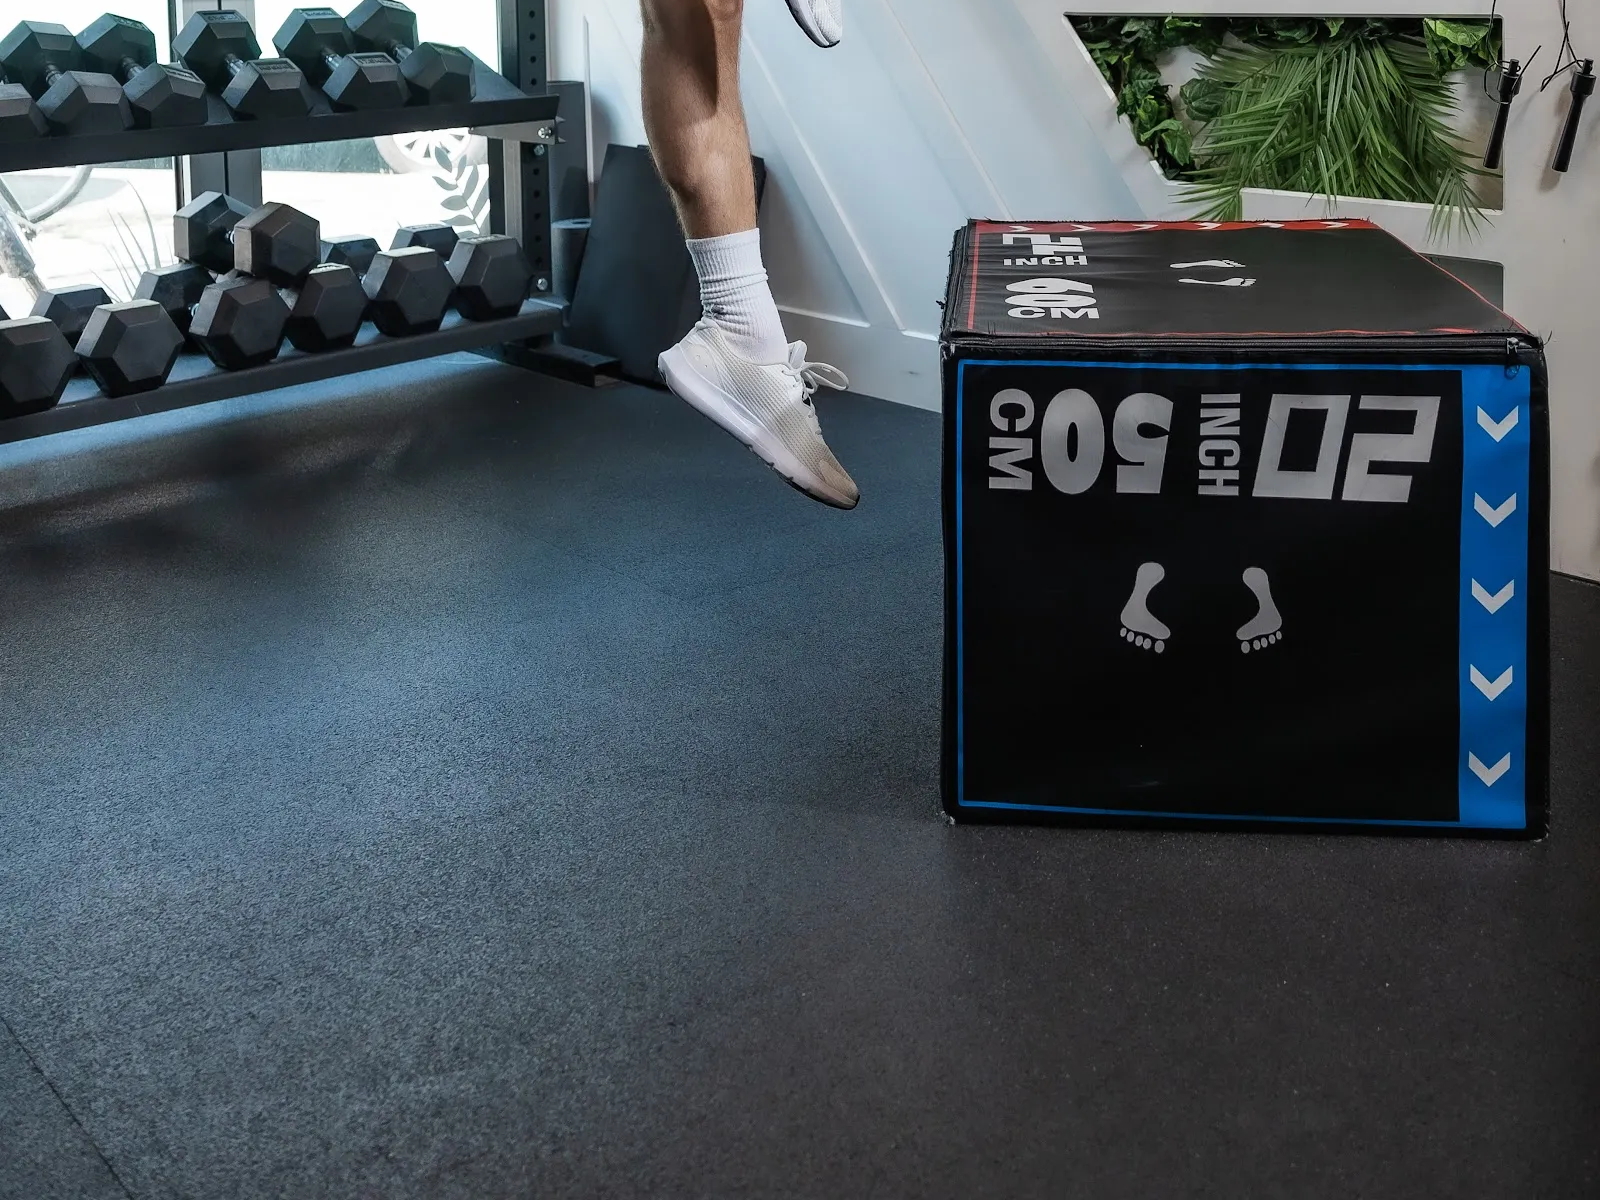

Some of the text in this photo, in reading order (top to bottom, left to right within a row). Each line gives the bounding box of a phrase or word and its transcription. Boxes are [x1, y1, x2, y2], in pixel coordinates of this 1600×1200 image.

[1003, 255, 1088, 266] INCH
[1004, 277, 1097, 308] 60
[1007, 306, 1100, 319] CM
[988, 388, 1442, 503] 20 INCH 50 CM
